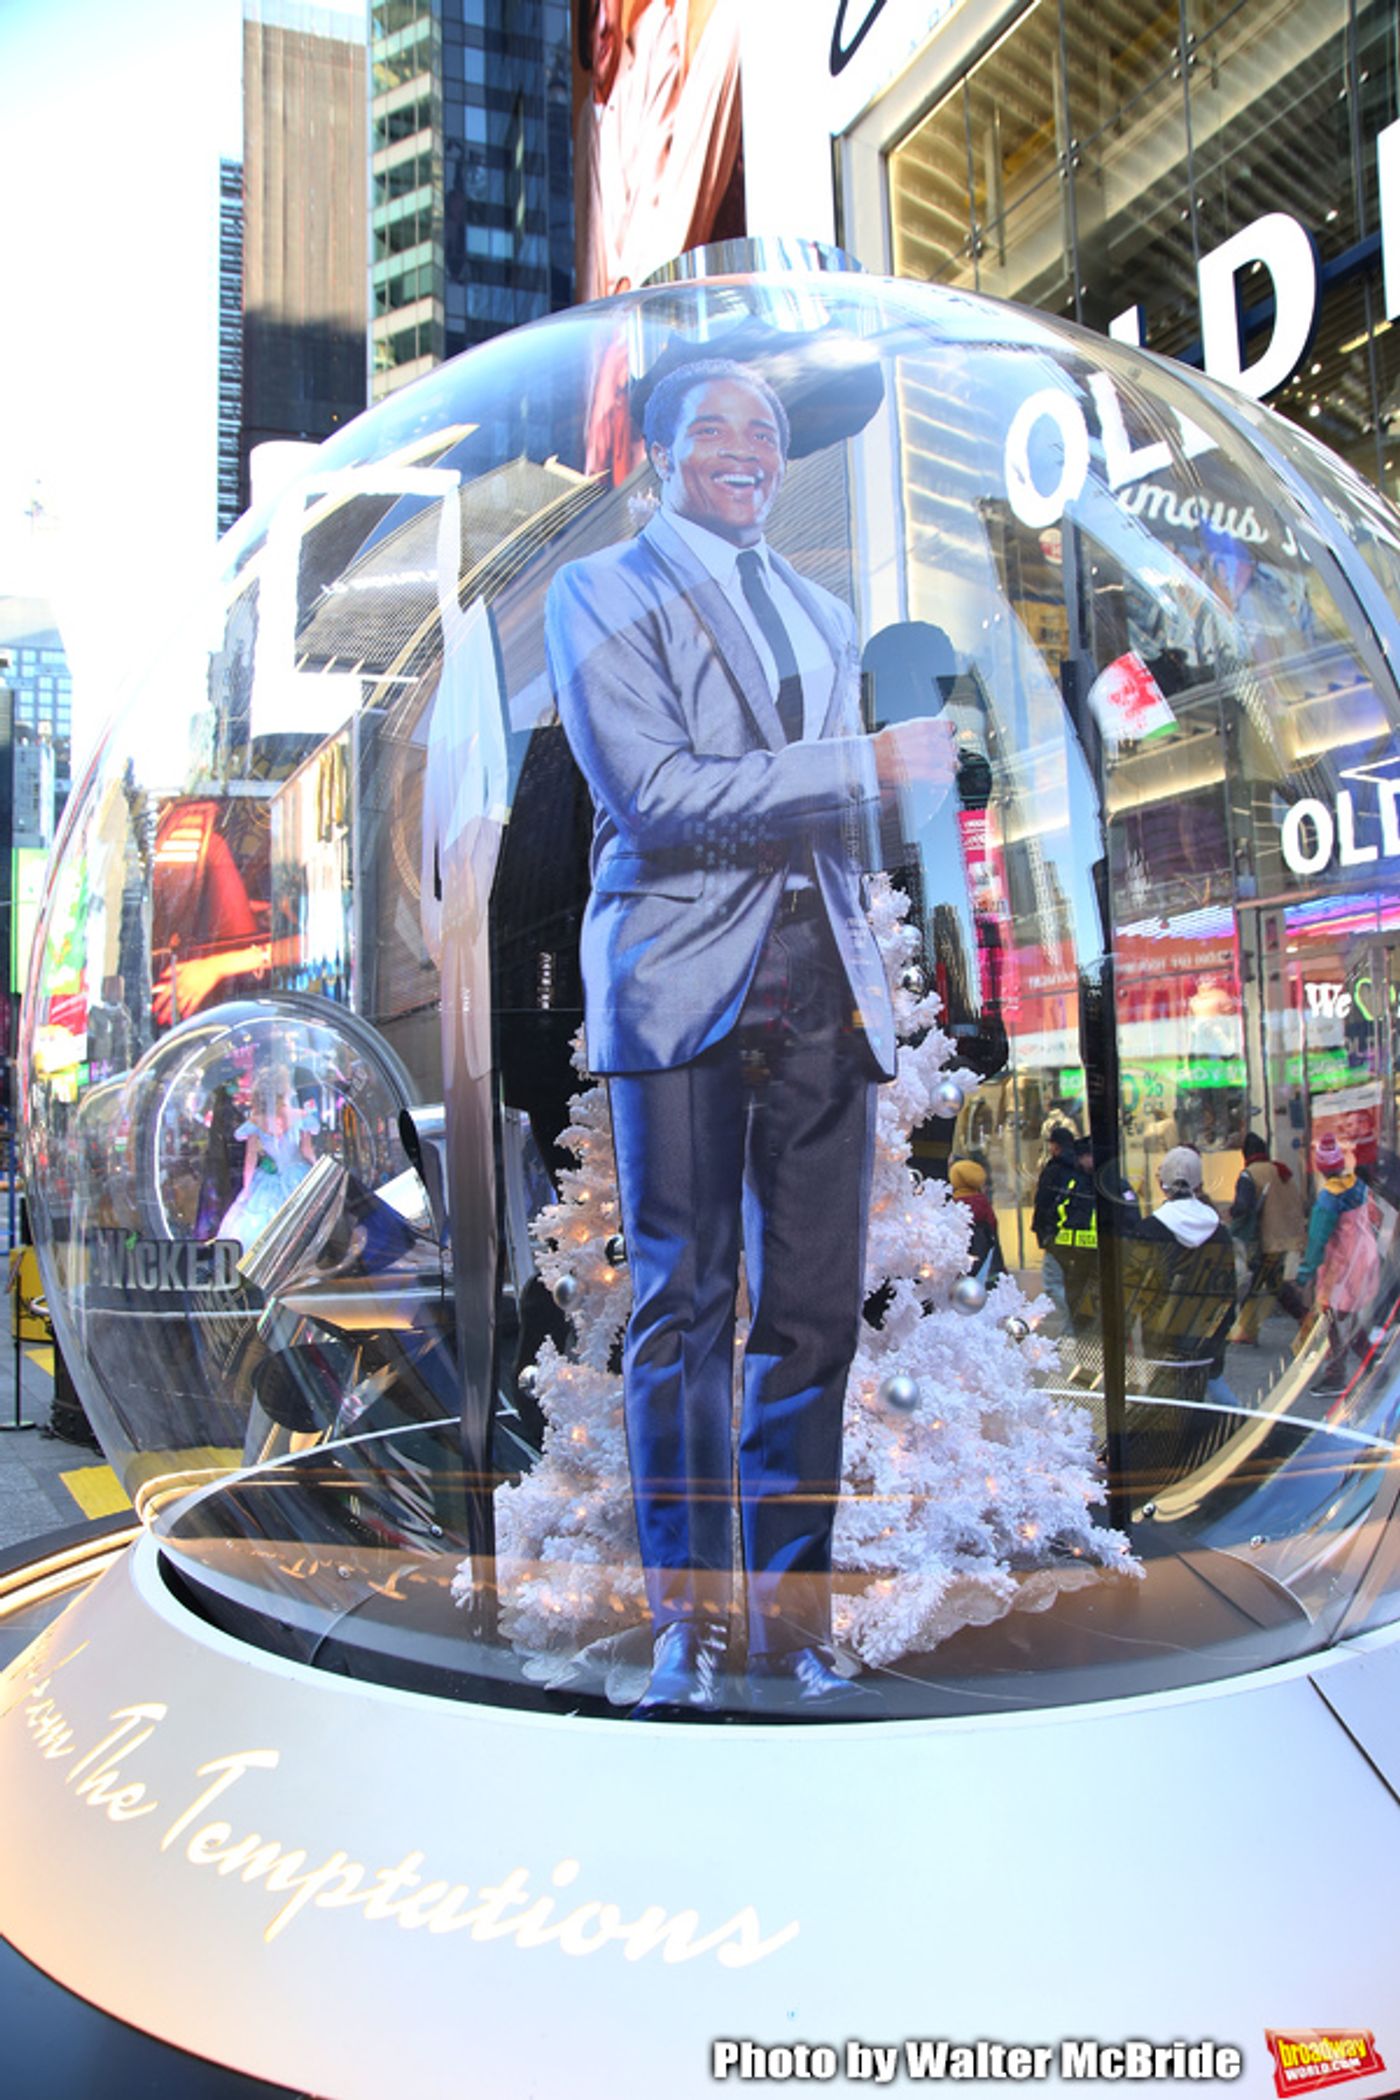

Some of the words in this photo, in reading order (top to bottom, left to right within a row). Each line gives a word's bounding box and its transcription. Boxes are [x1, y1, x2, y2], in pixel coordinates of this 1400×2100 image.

[1304, 982, 1352, 1018] We
[97, 1228, 241, 1291] WICKED
[66, 1703, 167, 1822] The
[161, 1749, 799, 1967] Temptations
